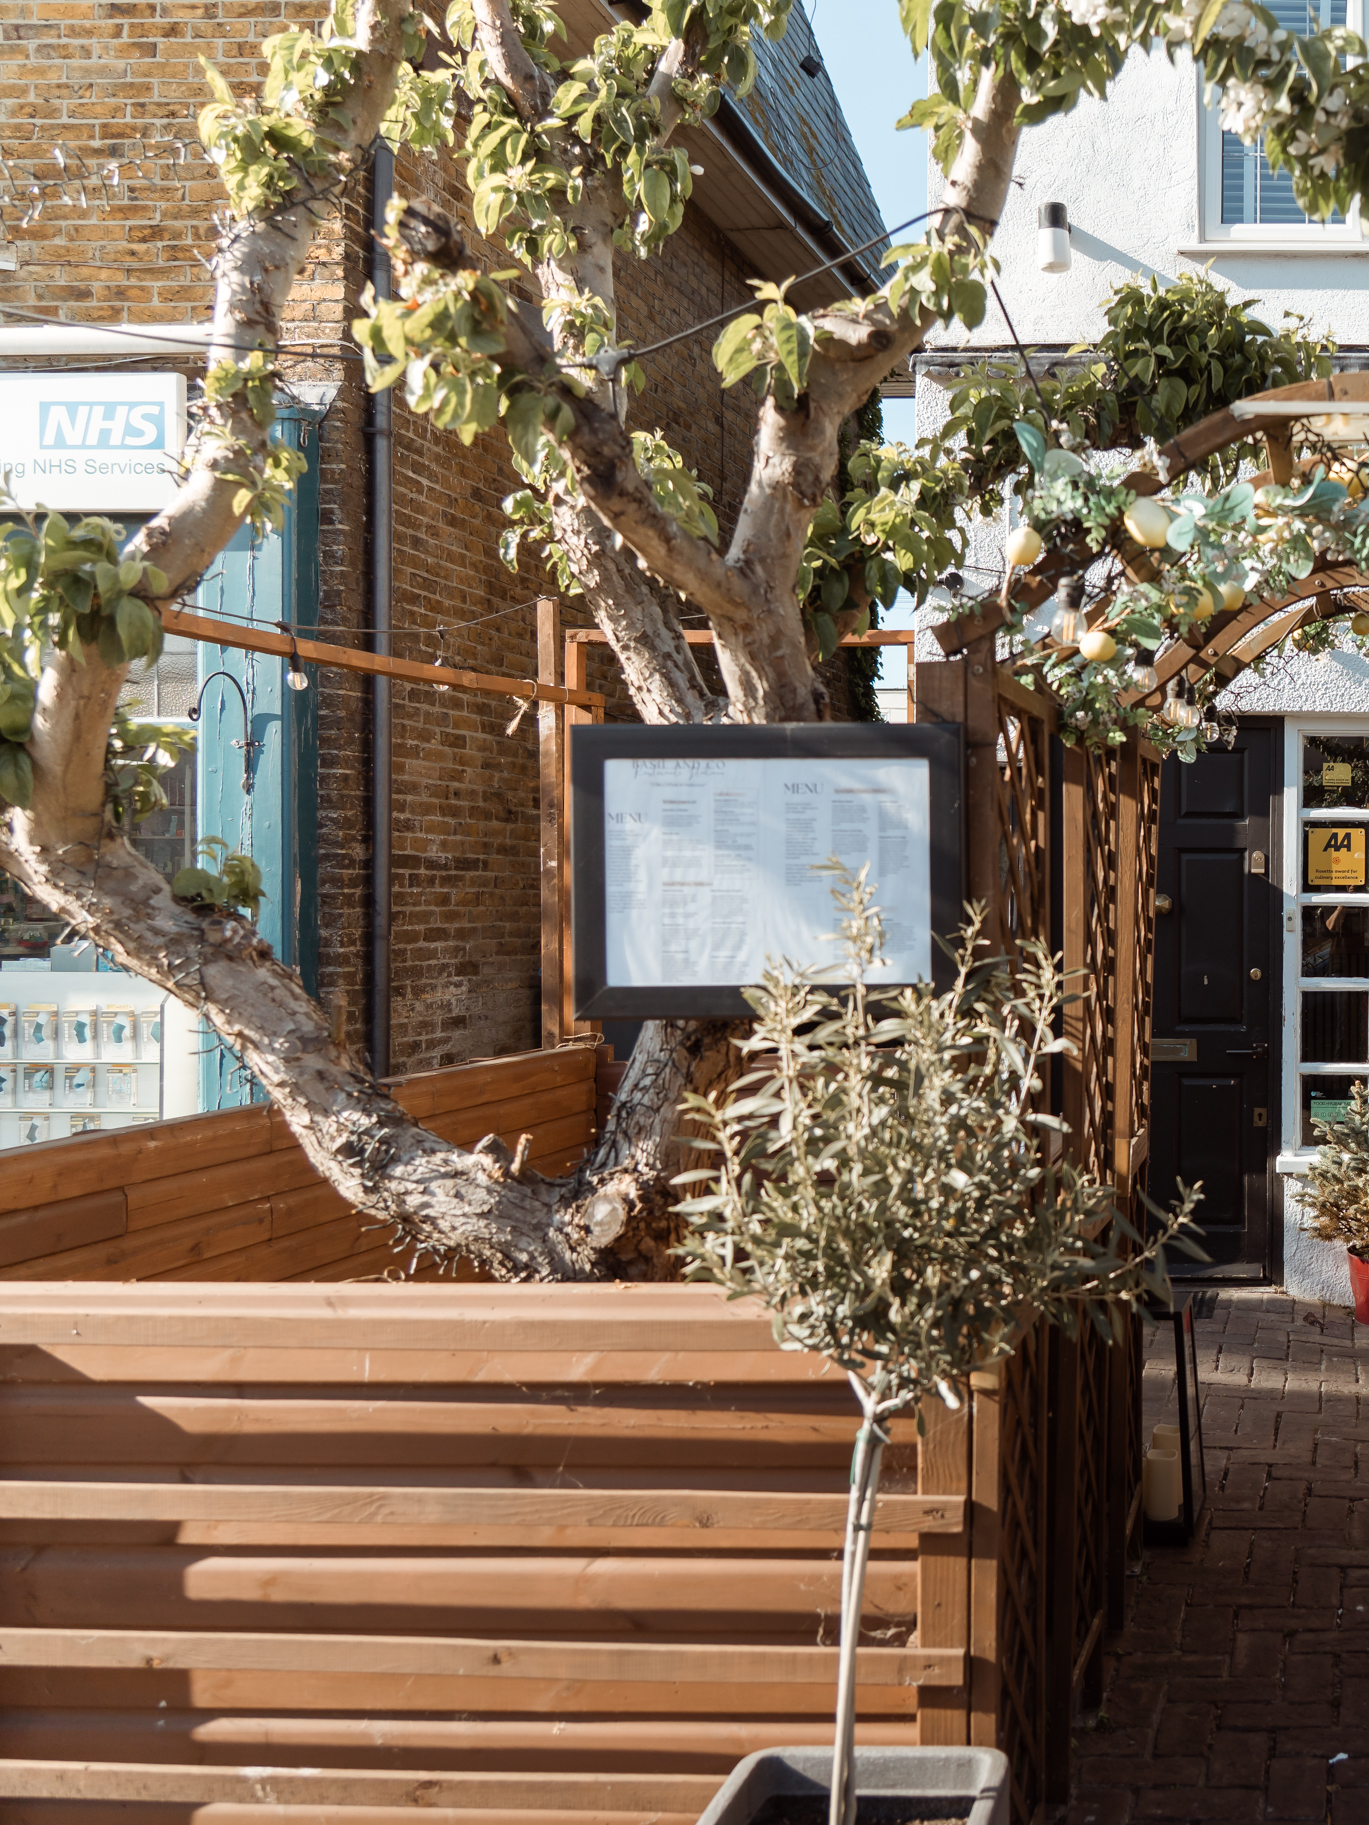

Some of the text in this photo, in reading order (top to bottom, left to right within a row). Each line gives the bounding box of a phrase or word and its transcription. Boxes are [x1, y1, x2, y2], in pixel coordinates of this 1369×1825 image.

[42, 404, 161, 447] NHS
[33, 459, 77, 474] NHS
[84, 459, 166, 475] Services
[783, 782, 825, 795] MENU
[607, 812, 648, 825] MENU
[1322, 832, 1352, 852] AA
